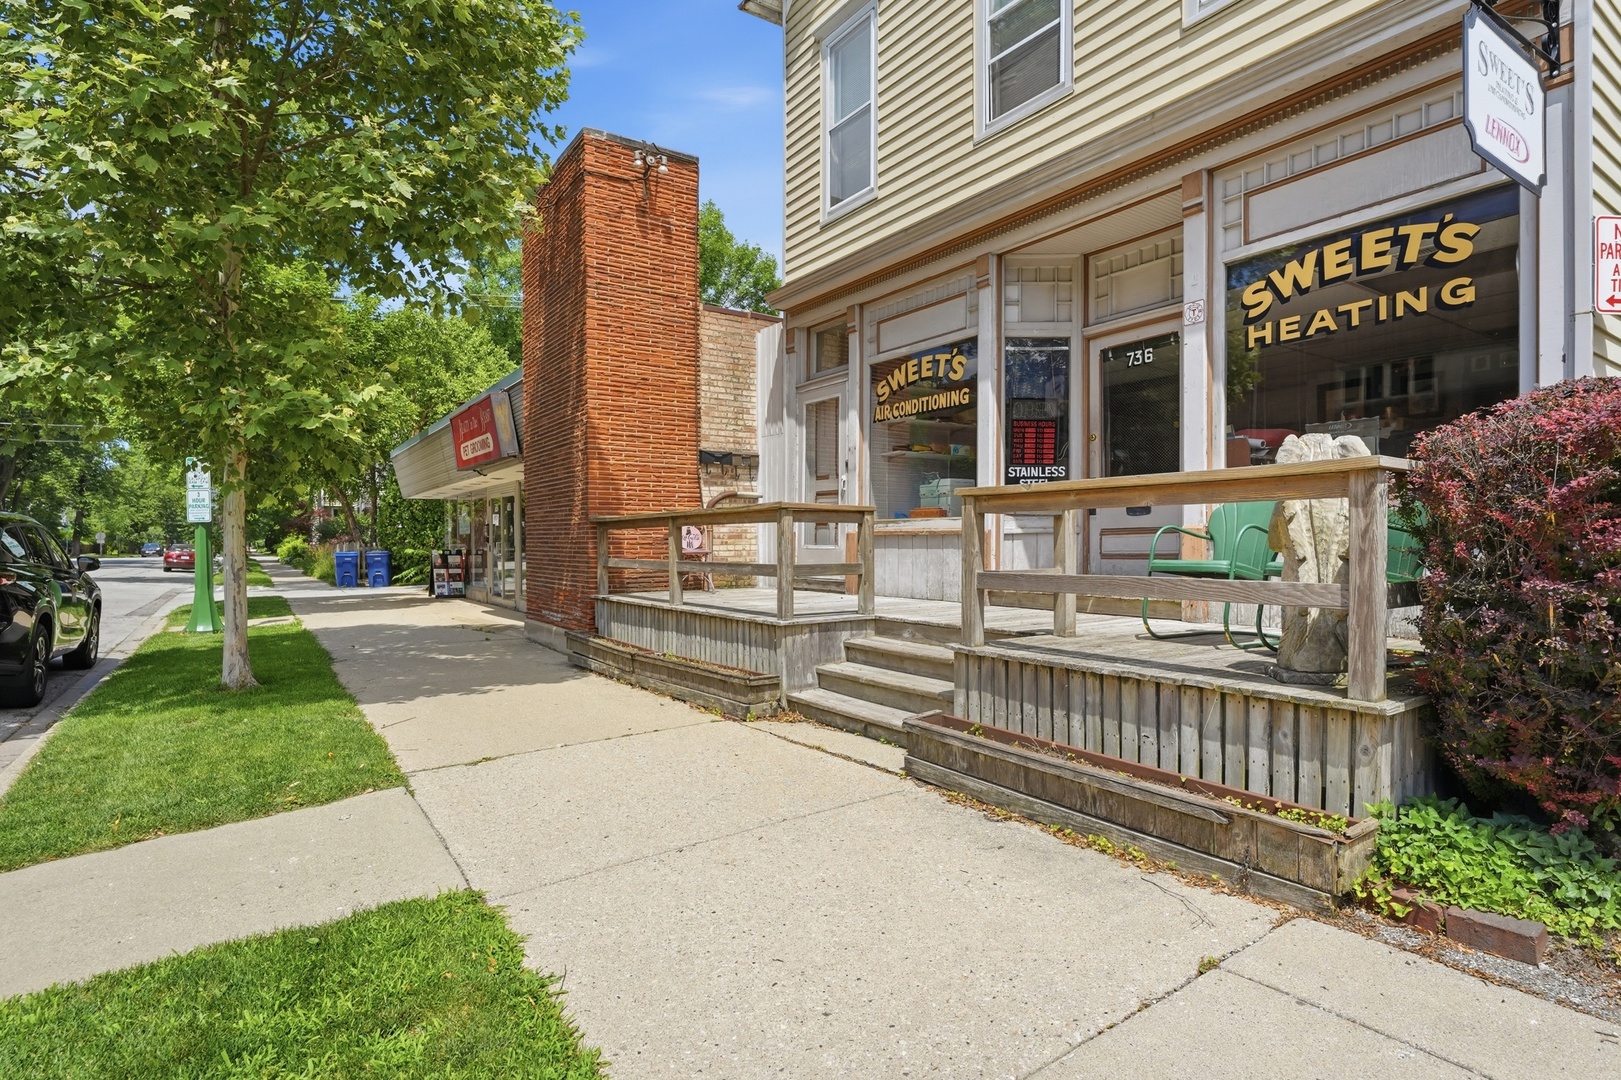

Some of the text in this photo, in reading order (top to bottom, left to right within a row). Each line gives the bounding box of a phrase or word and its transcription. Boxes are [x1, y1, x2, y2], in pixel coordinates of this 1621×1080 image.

[1477, 40, 1535, 116] SWEET'S
[1485, 114, 1521, 157] LENNOX
[1614, 223, 1621, 240] N
[1600, 242, 1621, 260] PAR
[1241, 212, 1482, 319] SWEET'S
[1612, 263, 1621, 277] A
[1246, 276, 1477, 350] HEATING
[1126, 348, 1154, 368] 736
[876, 347, 968, 403] SWEET'S
[874, 387, 970, 422] AIR CONDITIONING
[470, 436, 490, 454] GROOMING
[1008, 466, 1066, 478] STAINLESS
